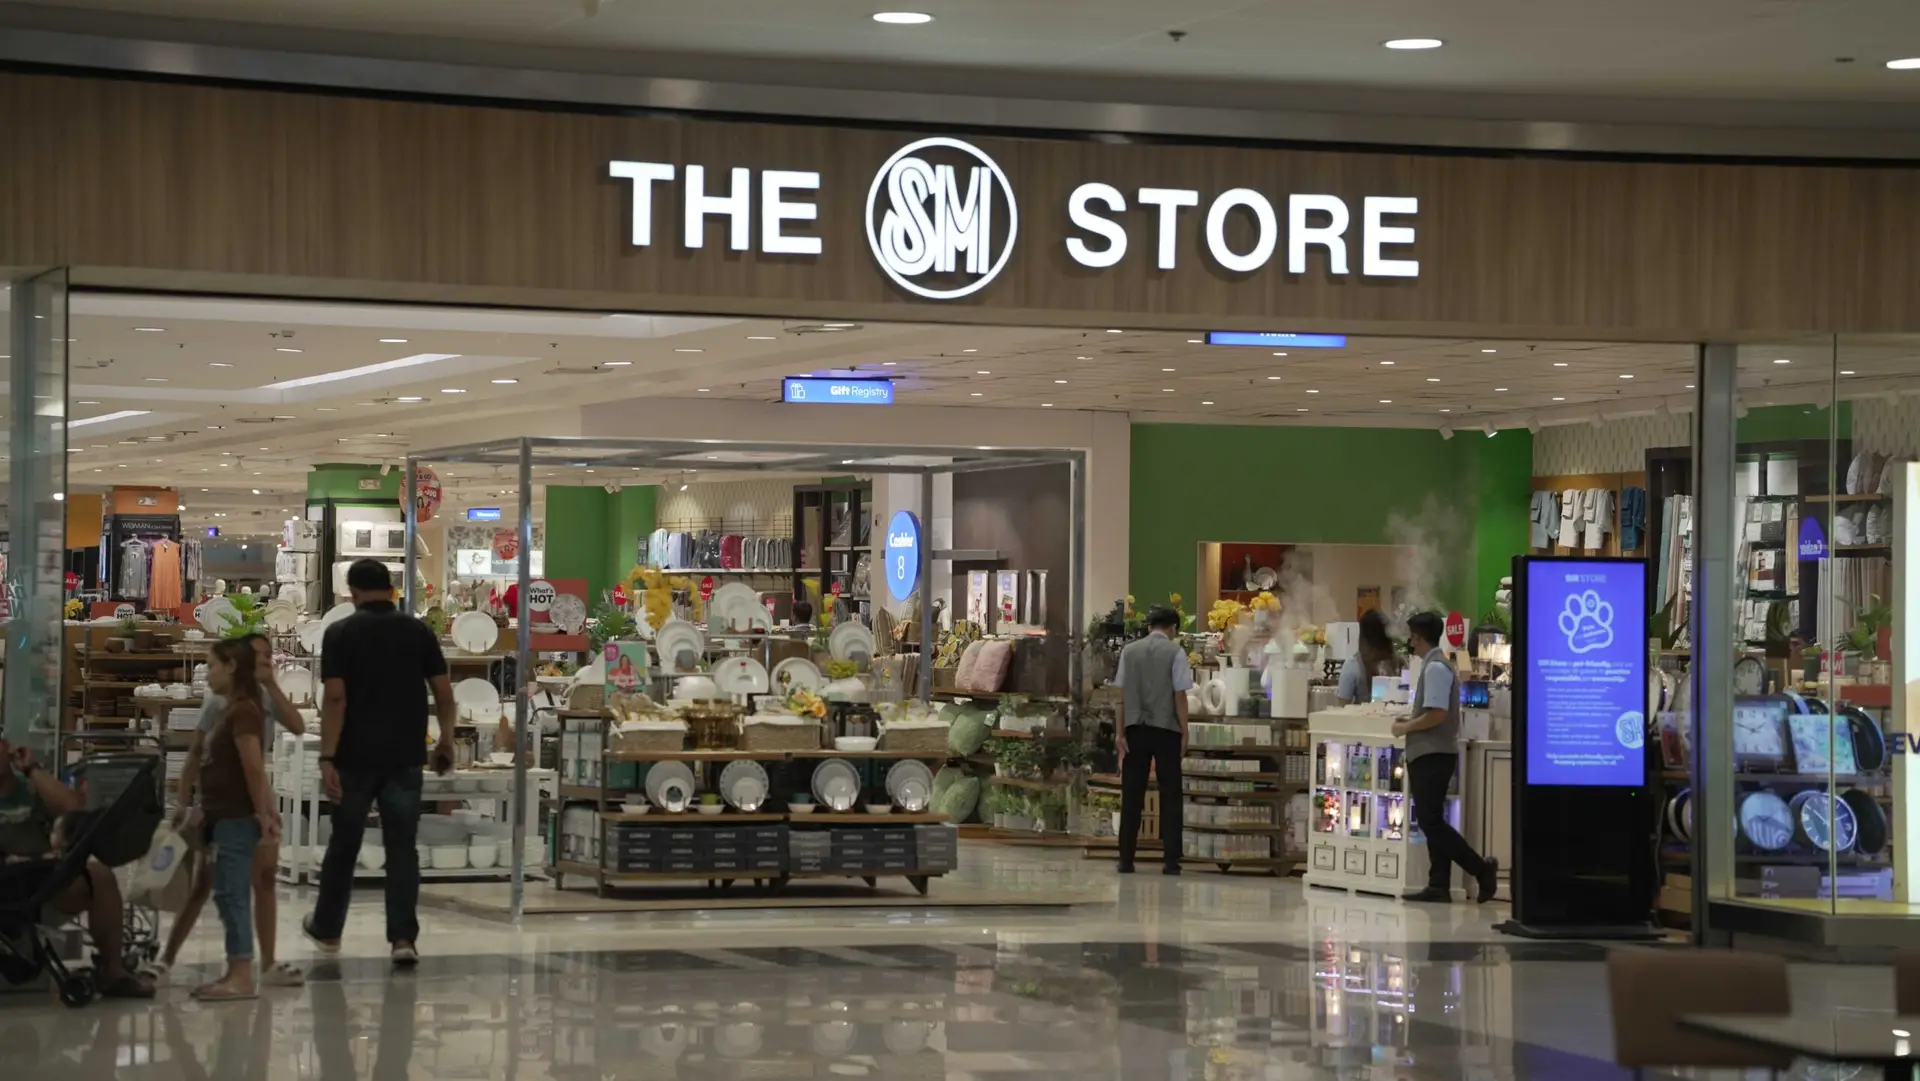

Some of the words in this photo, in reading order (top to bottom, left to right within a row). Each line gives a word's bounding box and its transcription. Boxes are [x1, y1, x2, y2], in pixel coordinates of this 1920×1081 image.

[609, 160, 822, 254] THE
[878, 155, 994, 277] SM
[1066, 182, 1419, 277] STORE
[830, 385, 851, 396] Gift
[851, 386, 888, 398] Registry
[890, 532, 913, 548] Cashier
[897, 555, 905, 580] 8
[530, 595, 554, 604] HOT
